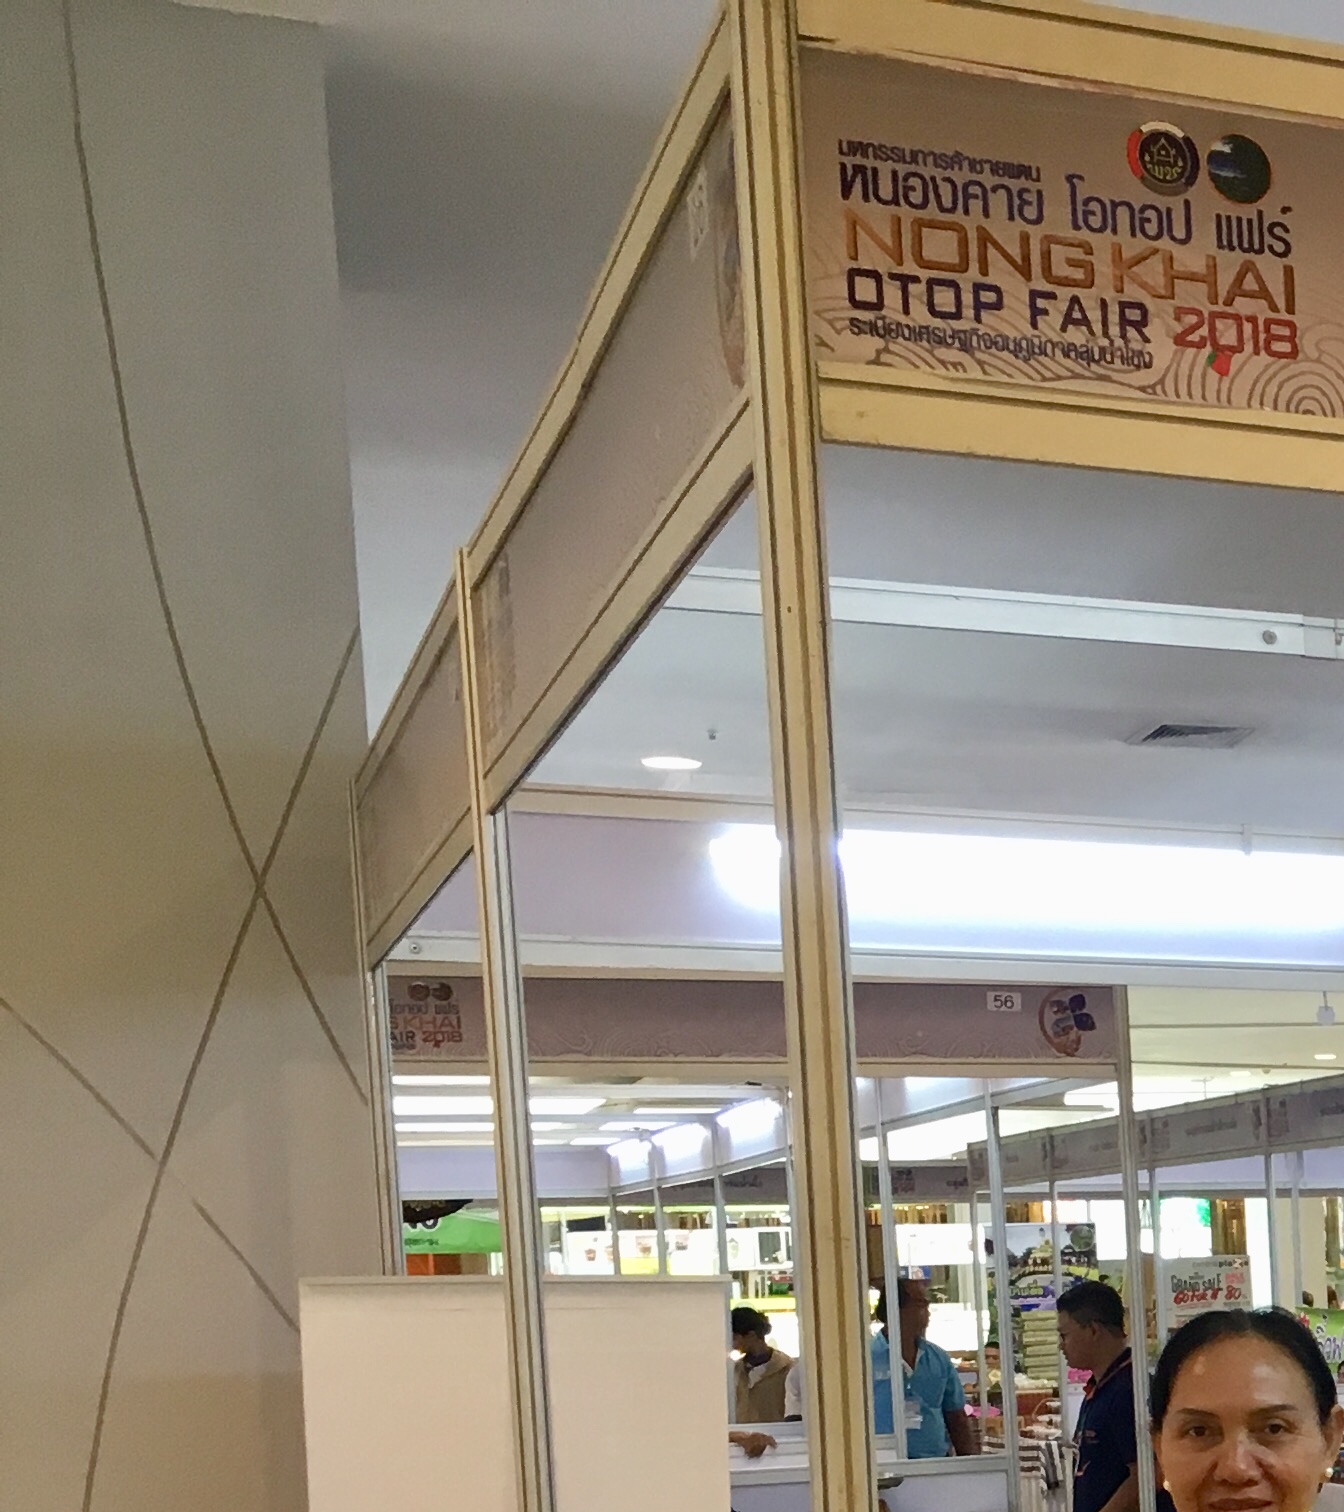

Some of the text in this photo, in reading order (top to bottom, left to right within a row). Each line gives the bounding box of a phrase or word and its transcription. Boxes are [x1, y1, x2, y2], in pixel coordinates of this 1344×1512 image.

[839, 162, 1292, 259] หนองคาย โอทอป แฟร์
[844, 210, 1297, 314] NONG KHAI
[847, 267, 1298, 360] OTOP FAIR 2018
[993, 994, 1015, 1009] 56
